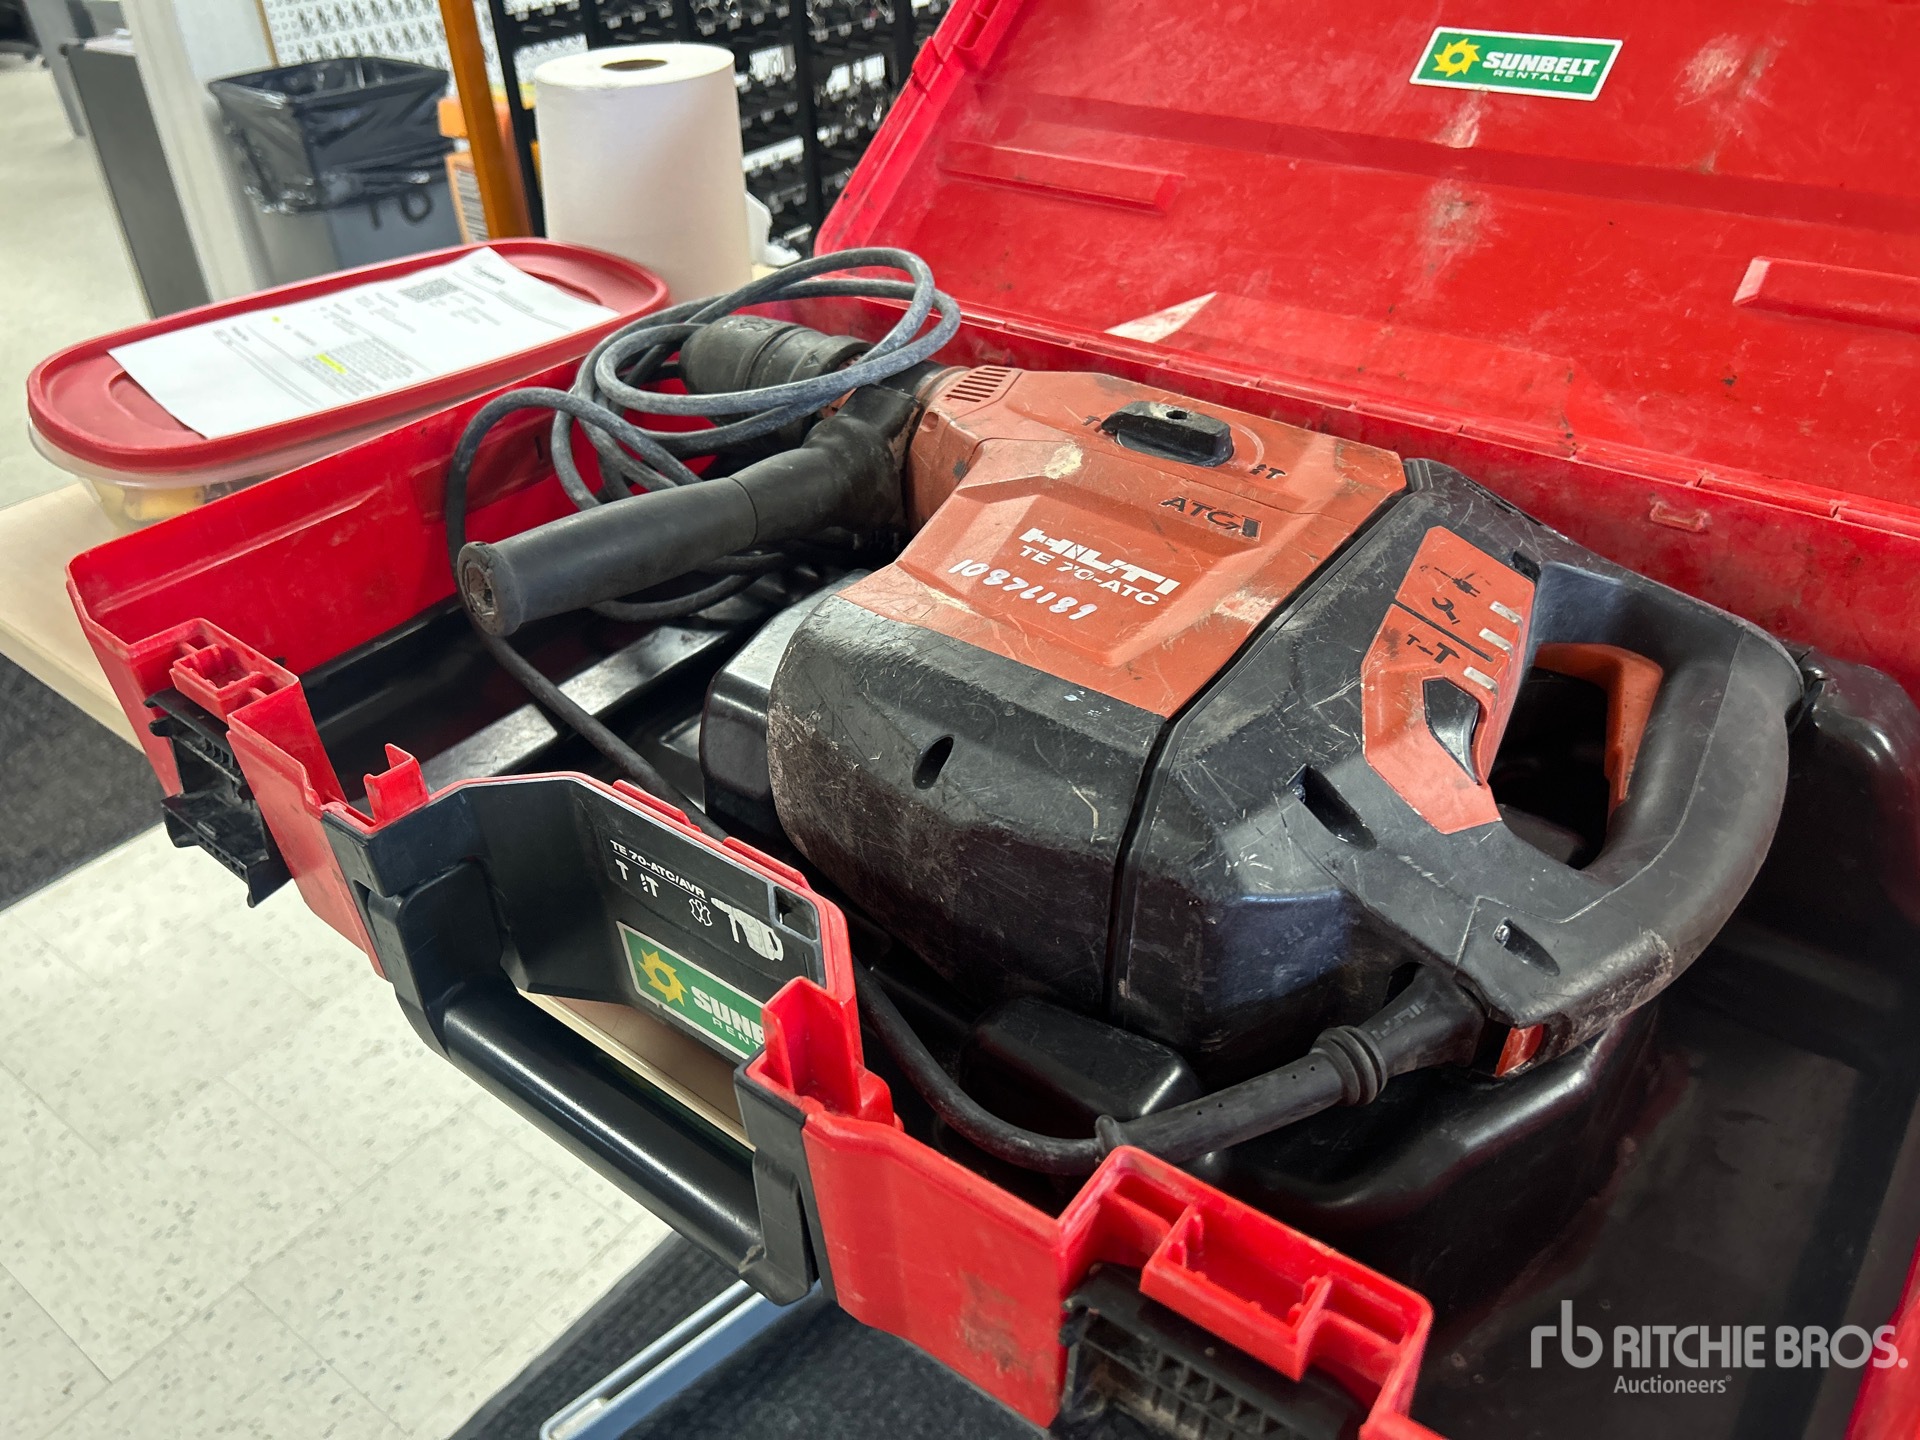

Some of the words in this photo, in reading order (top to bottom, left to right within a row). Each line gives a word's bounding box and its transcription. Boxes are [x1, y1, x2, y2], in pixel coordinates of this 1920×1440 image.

[1482, 51, 1600, 77] SUNBELT
[1493, 69, 1574, 83] RENTALS
[1019, 527, 1181, 595] HILTI
[1019, 545, 1055, 566] TE
[1056, 561, 1160, 606] 70-ATC
[610, 840, 628, 857] TE
[629, 850, 707, 899] 70-ATC/AVR
